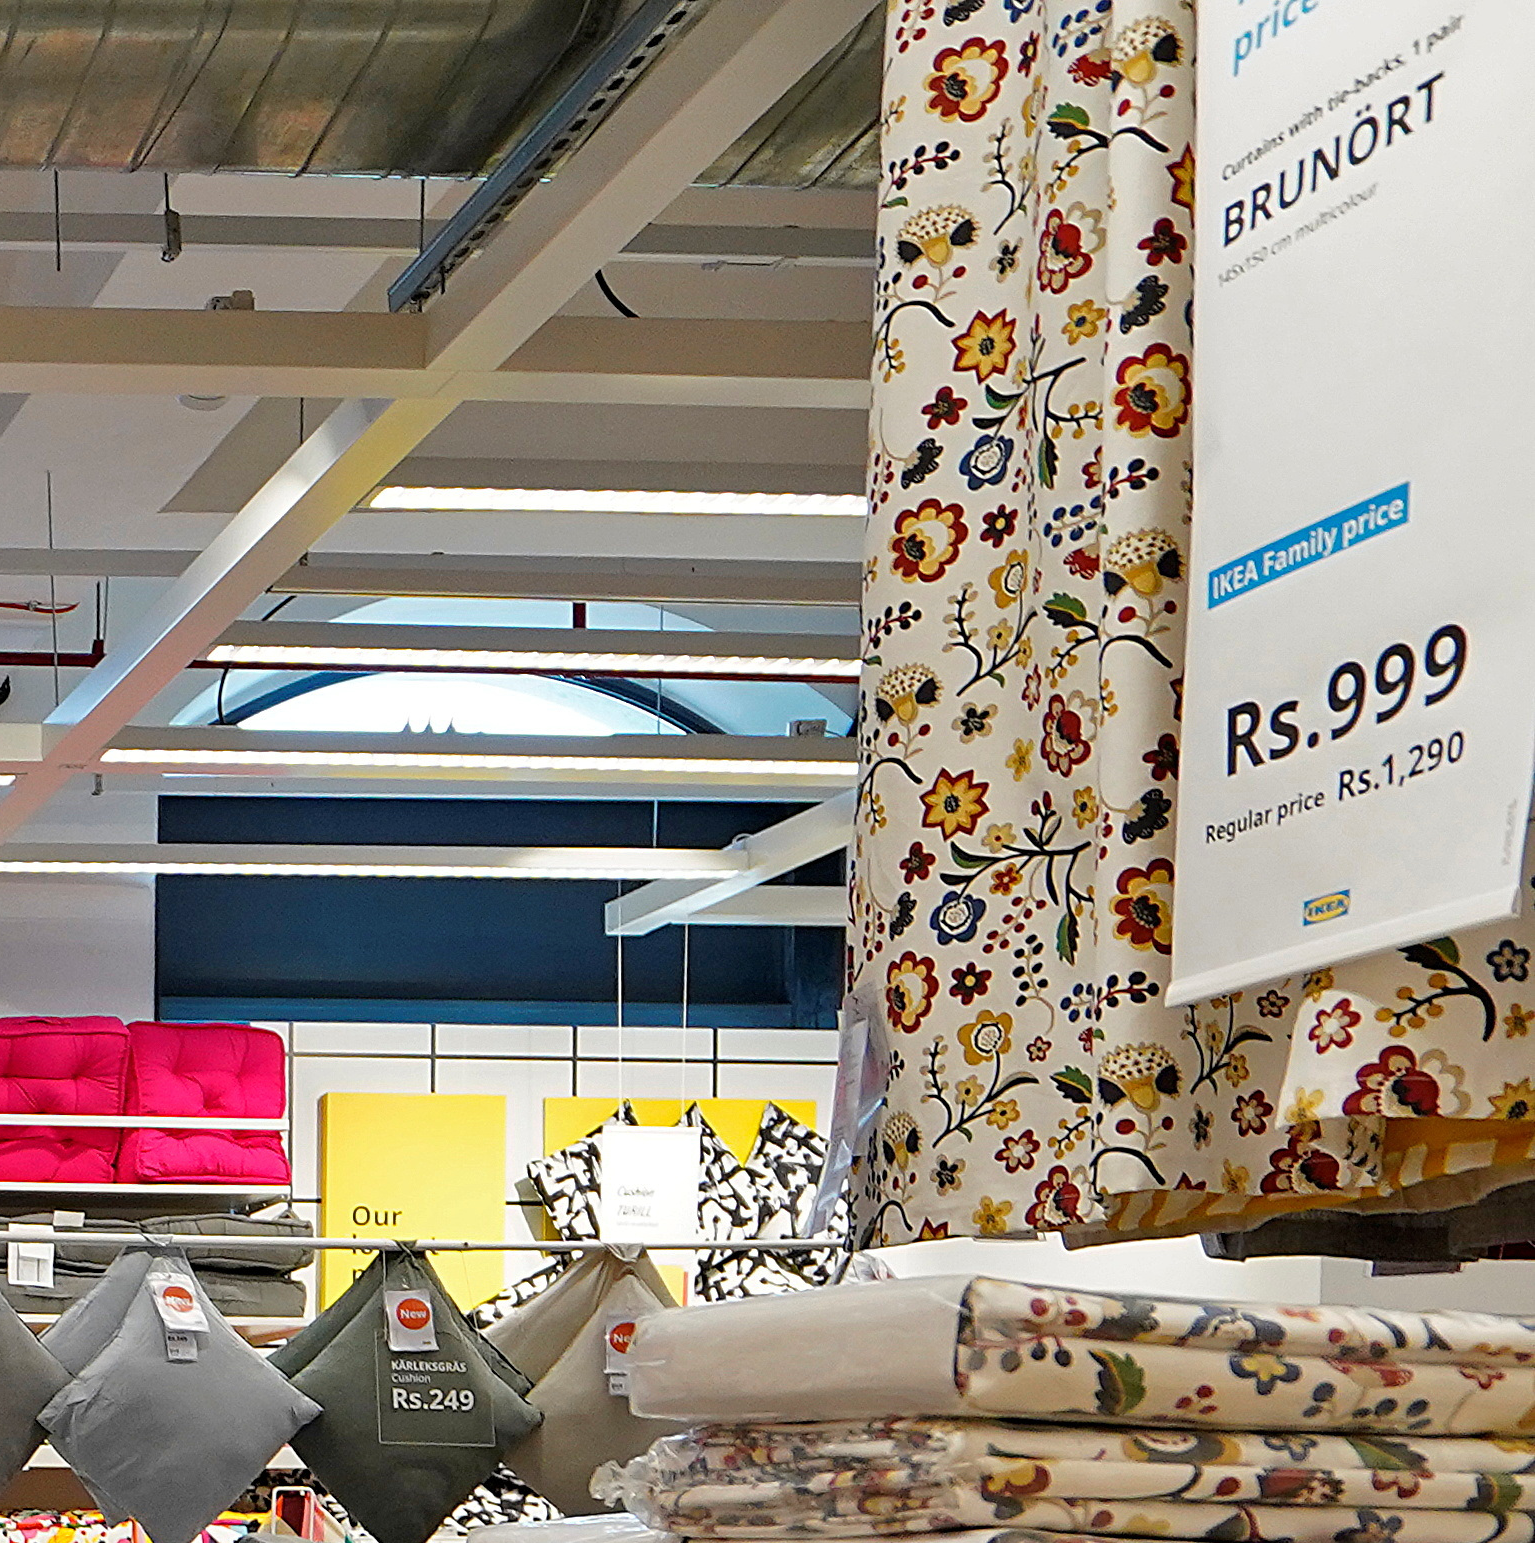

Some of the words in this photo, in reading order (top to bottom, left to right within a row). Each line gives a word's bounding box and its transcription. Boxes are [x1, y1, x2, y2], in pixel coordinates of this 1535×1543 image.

[1222, 71, 1445, 248] BRUNÖRT
[1212, 558, 1258, 600] IKEA
[1262, 526, 1338, 576] Family
[1342, 498, 1405, 548] price
[1226, 623, 1469, 778] Rs.999
[1205, 802, 1273, 844] Regular
[1276, 790, 1325, 825] price
[1338, 730, 1465, 802] Rs.1,290
[352, 1205, 403, 1227] Our
[399, 1308, 426, 1320] New
[391, 1373, 431, 1384] Cushion
[391, 1387, 475, 1411] Rs.249
